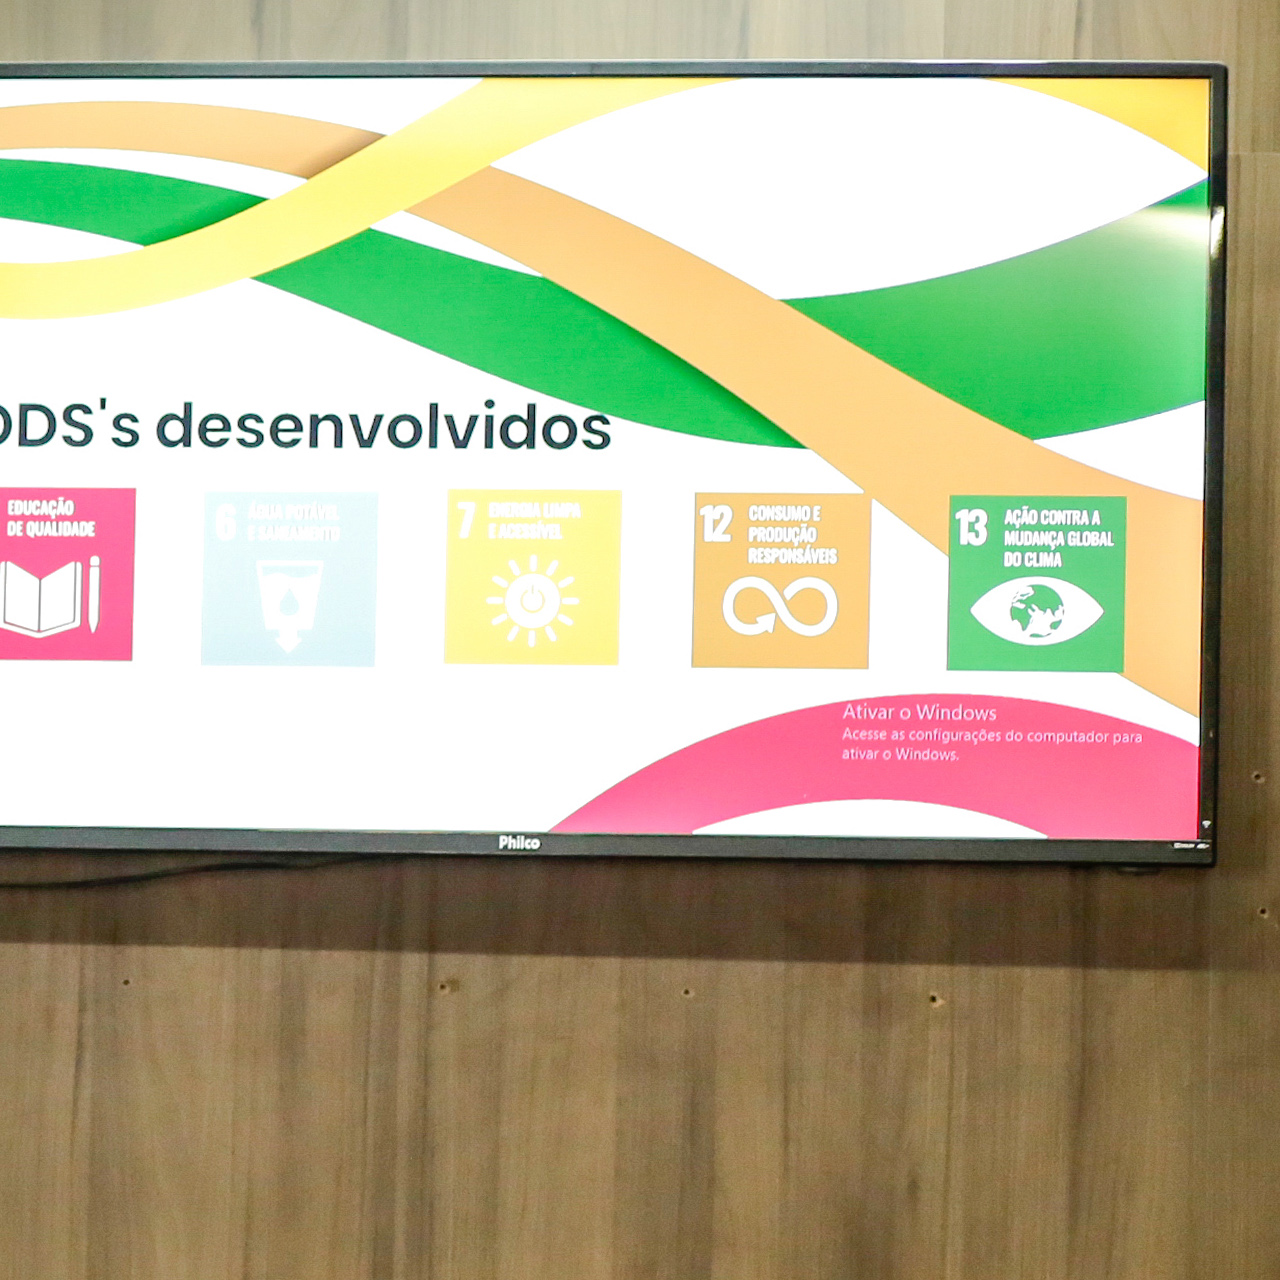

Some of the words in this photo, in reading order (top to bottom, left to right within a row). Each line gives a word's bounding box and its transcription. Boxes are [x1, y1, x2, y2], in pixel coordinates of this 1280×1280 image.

[156, 399, 611, 450] desenvolvidos
[7, 497, 75, 519] EDUCAÇÃO
[748, 505, 811, 521] CONSUMO
[813, 506, 821, 521] E
[1004, 505, 1038, 528] AÇÃO
[1040, 509, 1089, 525] CONTRA
[1091, 510, 1100, 525] A
[7, 521, 24, 536] DE
[26, 521, 96, 538] QUALIDADE
[215, 503, 237, 541] 6
[457, 501, 476, 539] 7
[699, 504, 733, 542] 12
[955, 508, 988, 546] 13
[748, 523, 817, 546] PRODUÇÃO
[1004, 530, 1065, 550] MUDANÇA
[1067, 532, 1114, 547] GLOBAL
[748, 544, 838, 564] RESPONSÁVEIS
[1003, 552, 1021, 567] DO
[1024, 552, 1062, 567] CLIMA
[842, 703, 894, 720] Ativar
[900, 708, 911, 720] o
[916, 704, 997, 721] Windows
[842, 727, 887, 741] Acesse
[891, 730, 905, 741] as
[909, 728, 1001, 746] configurações
[1005, 729, 1023, 742] do
[1027, 730, 1109, 747] computador
[1113, 733, 1143, 746] para
[842, 747, 879, 760] ativar
[883, 751, 892, 760] o
[895, 747, 959, 761] Windows.
[498, 835, 541, 850] Philco
